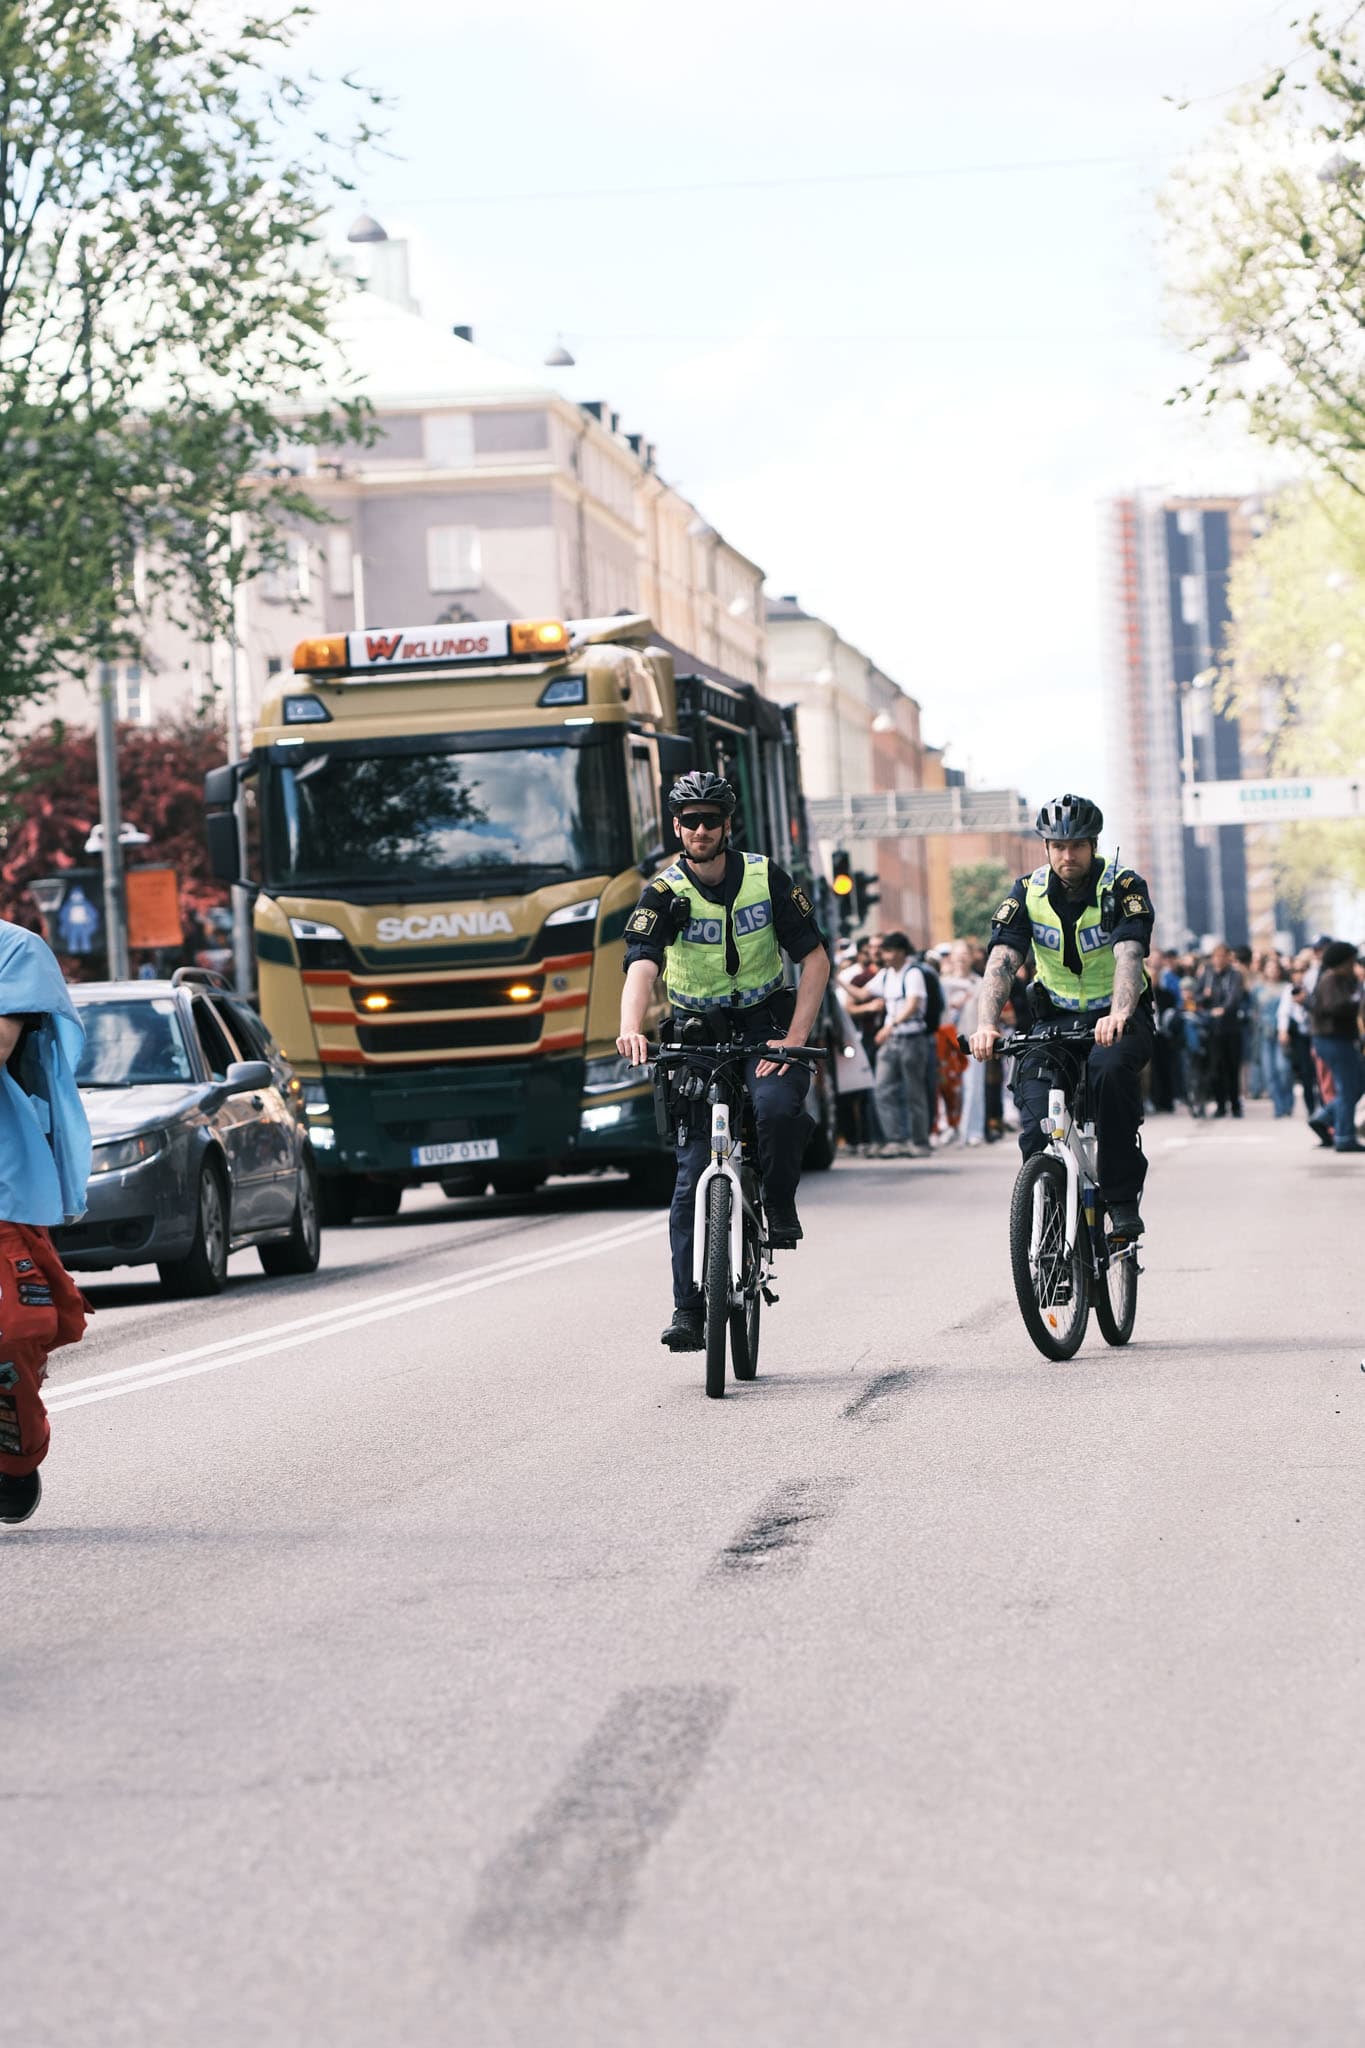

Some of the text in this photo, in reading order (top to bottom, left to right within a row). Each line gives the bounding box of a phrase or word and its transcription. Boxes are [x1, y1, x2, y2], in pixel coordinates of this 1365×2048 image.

[365, 634, 489, 661] WIKLUNDS
[377, 911, 512, 941] SCANIA
[424, 1144, 455, 1161] UUP
